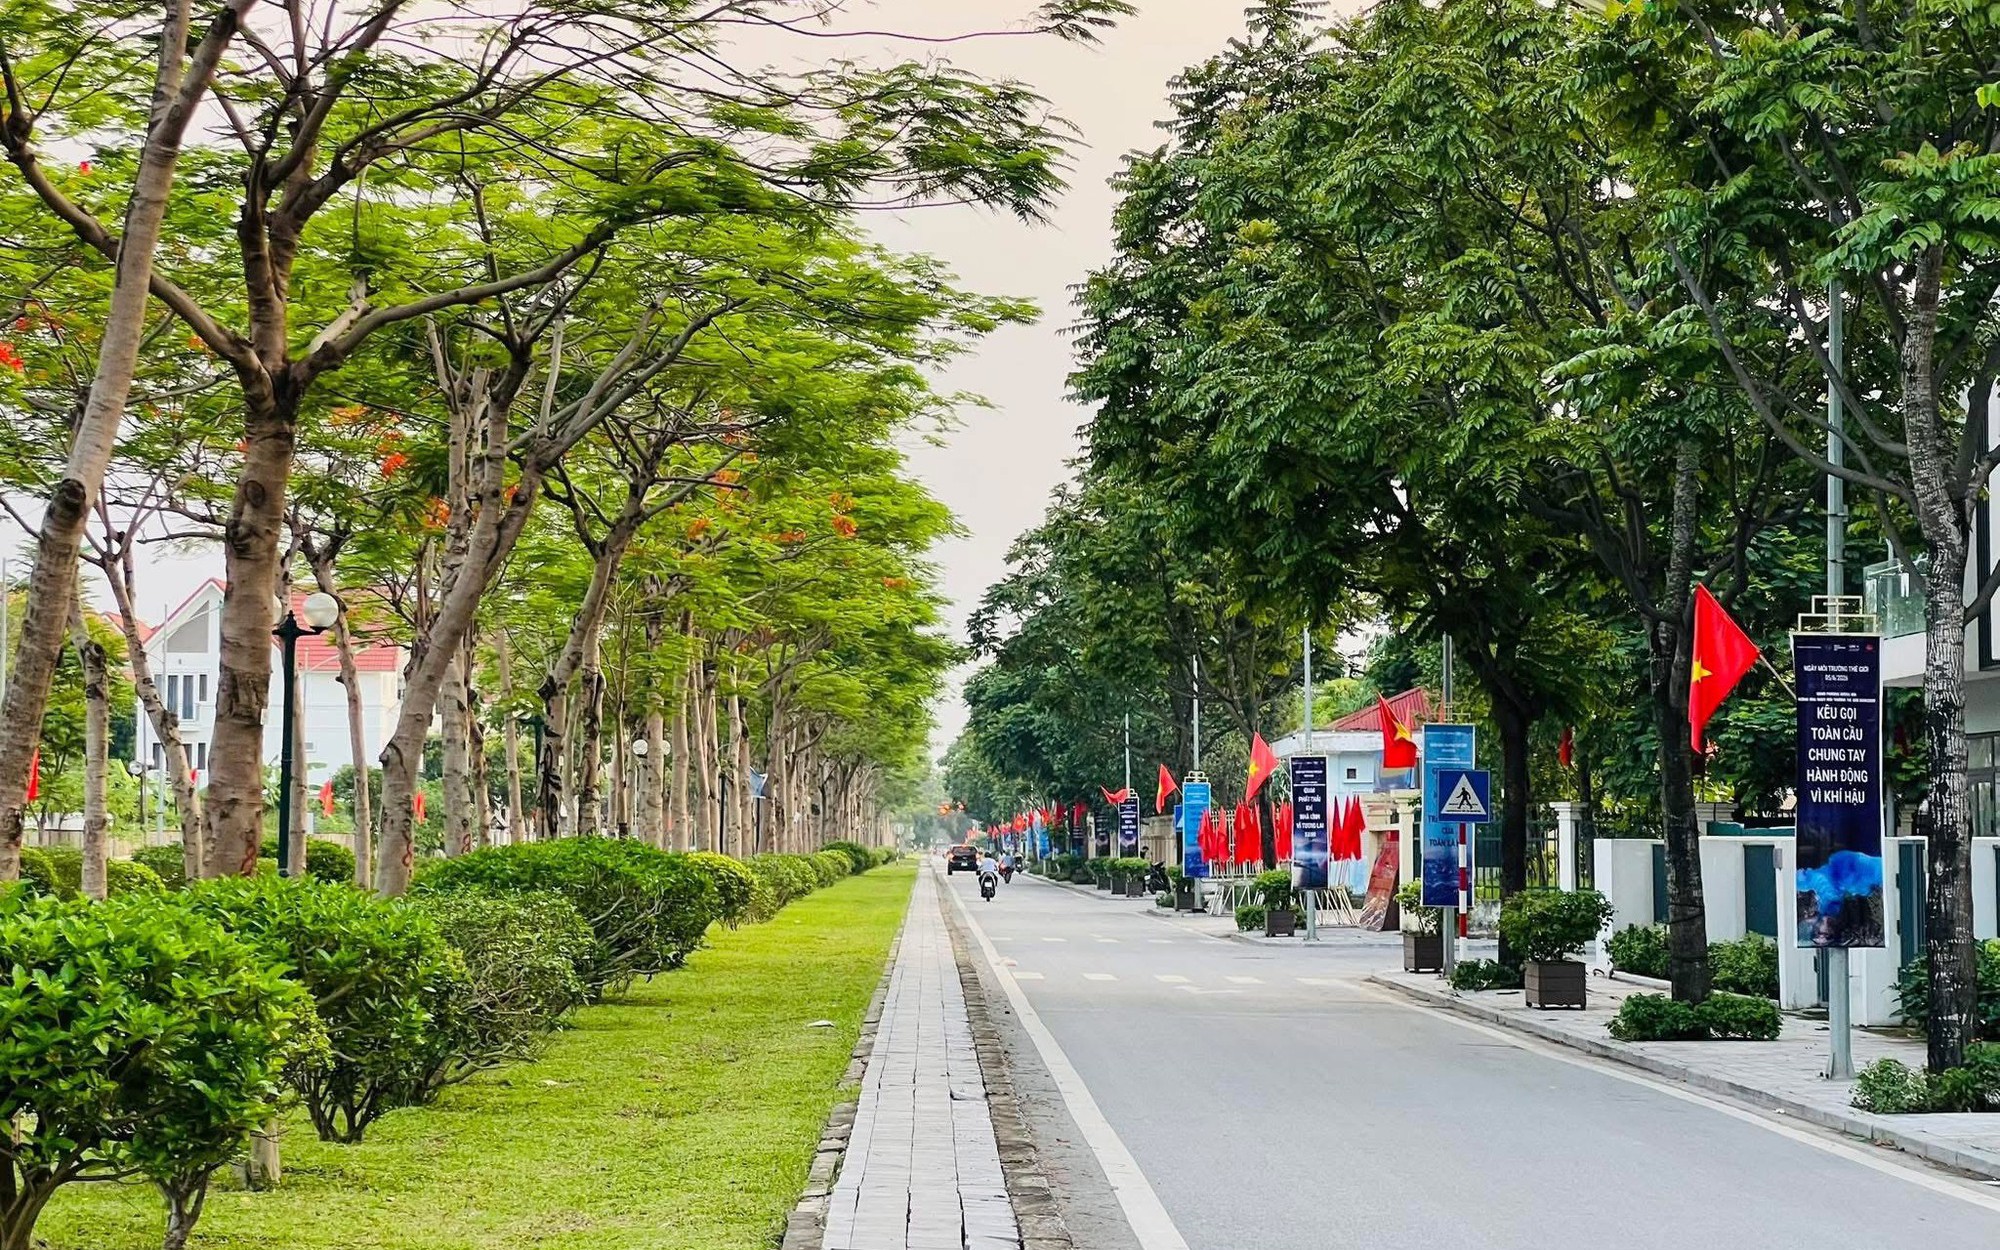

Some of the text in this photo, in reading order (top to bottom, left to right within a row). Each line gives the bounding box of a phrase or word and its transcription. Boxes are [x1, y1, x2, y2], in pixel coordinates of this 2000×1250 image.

[1817, 704, 1857, 723] KÊU GỌI
[1810, 724, 1863, 741] TOÀN CẦU
[1808, 748, 1866, 762] CHUNG TAY
[1806, 766, 1869, 785] HÀNH ĐỘNG
[1810, 787, 1865, 806] VÌ KHÍ HẬU
